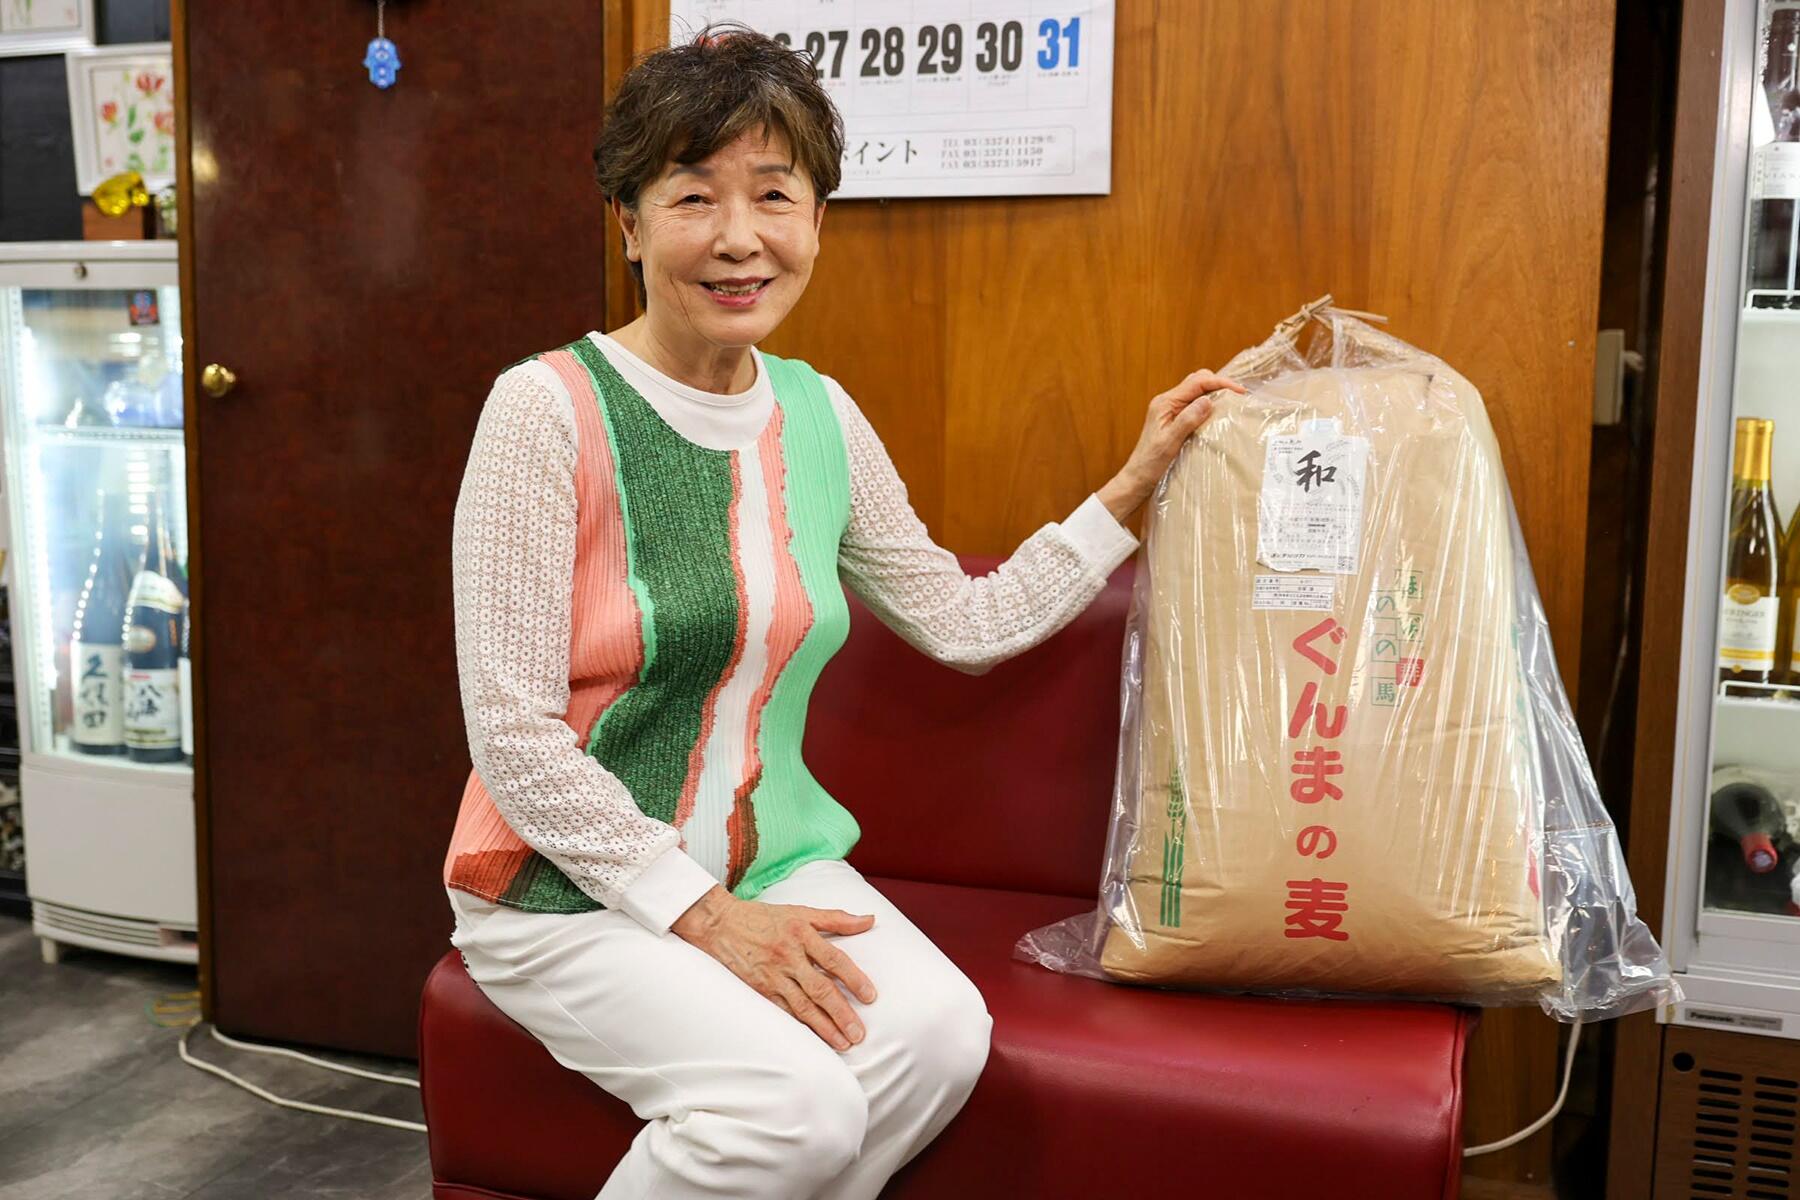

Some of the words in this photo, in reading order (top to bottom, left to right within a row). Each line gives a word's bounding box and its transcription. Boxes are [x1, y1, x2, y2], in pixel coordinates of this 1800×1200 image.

[806, 30, 848, 79] 27
[860, 27, 904, 77] 28
[917, 23, 962, 74] 29
[976, 21, 1023, 72] 30
[1037, 17, 1080, 70] 31
[1294, 449, 1337, 493] 和
[1284, 617, 1350, 942] ぐんまの麦
